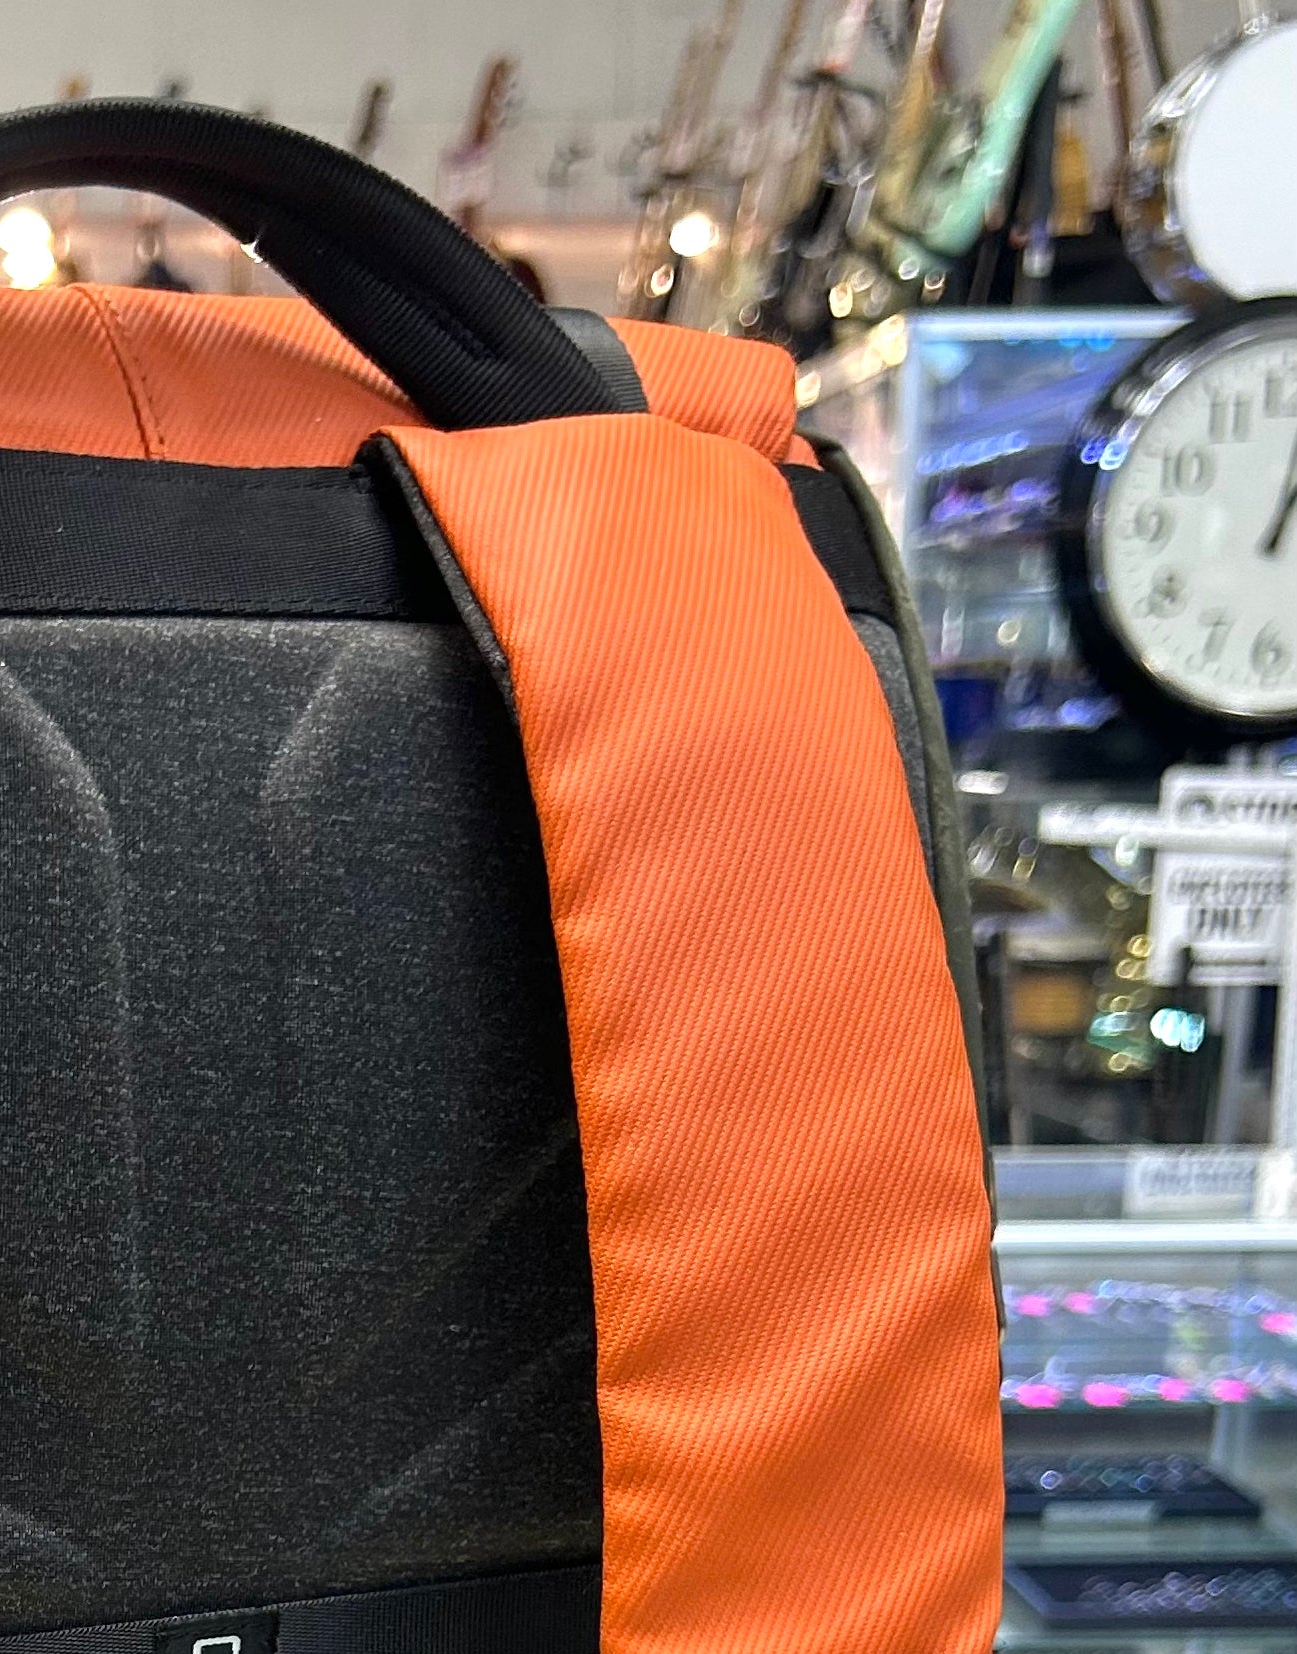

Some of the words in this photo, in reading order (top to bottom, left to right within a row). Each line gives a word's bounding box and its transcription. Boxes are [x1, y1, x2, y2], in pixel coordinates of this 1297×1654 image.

[1206, 387, 1252, 442] 11
[1161, 443, 1216, 497] 10
[1134, 499, 1173, 552] 9
[1150, 564, 1187, 619] 8
[1198, 606, 1233, 663] 7
[1250, 619, 1292, 679] 6
